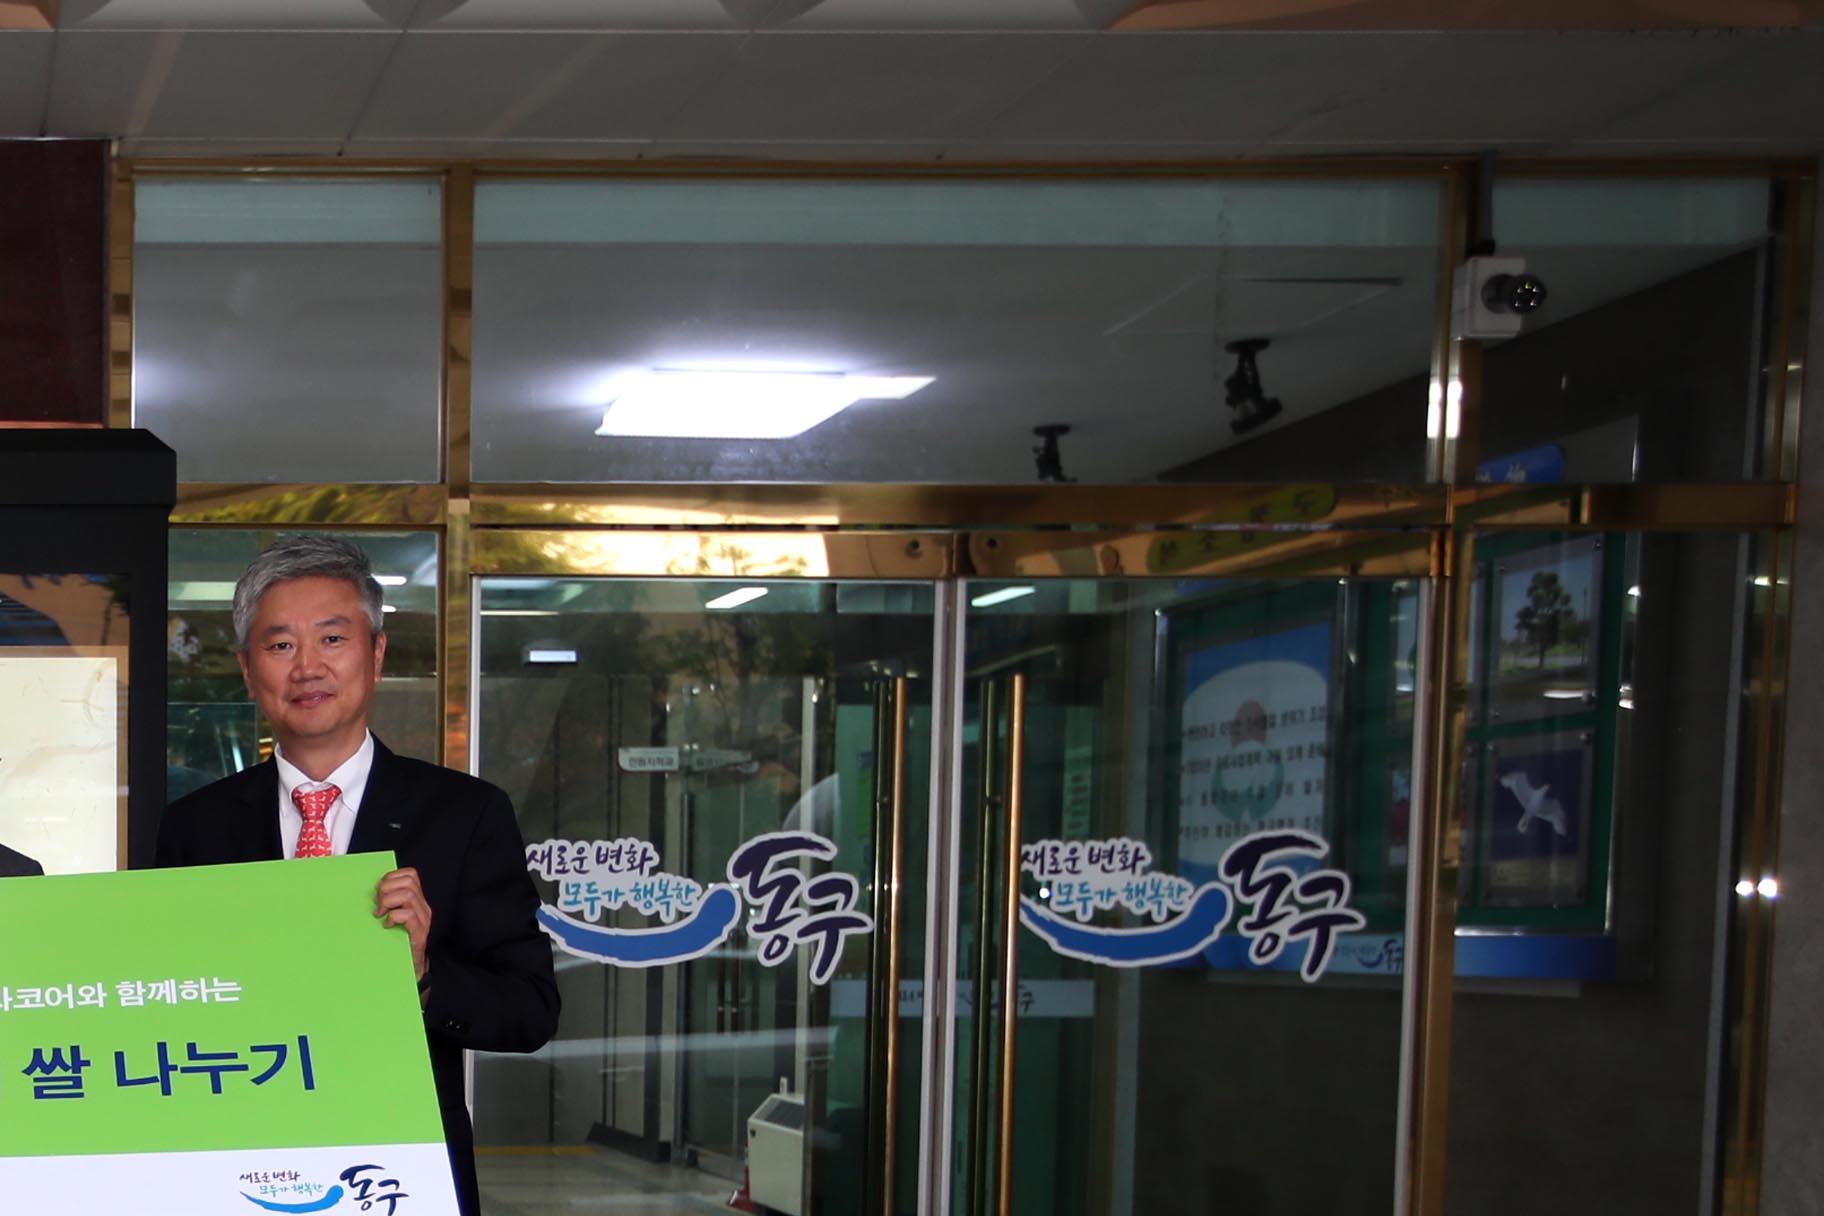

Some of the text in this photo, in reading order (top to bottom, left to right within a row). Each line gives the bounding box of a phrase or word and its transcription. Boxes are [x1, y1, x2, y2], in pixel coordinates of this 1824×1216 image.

[528, 840, 655, 876] 새로운 변화
[1022, 841, 1145, 877] 새로운 변화
[563, 881, 696, 919] 모두가 행복한
[731, 835, 872, 977] 동구
[1055, 879, 1187, 917] 모두가 행복한
[1224, 836, 1359, 976] 동구
[116, 977, 242, 1007] 함께하는
[23, 1044, 91, 1100] 쌀
[116, 1036, 316, 1097] 나누기
[239, 1171, 300, 1184] 새로운 변화
[260, 1182, 324, 1198] 모두가 행복한
[341, 1166, 409, 1216] 동구
